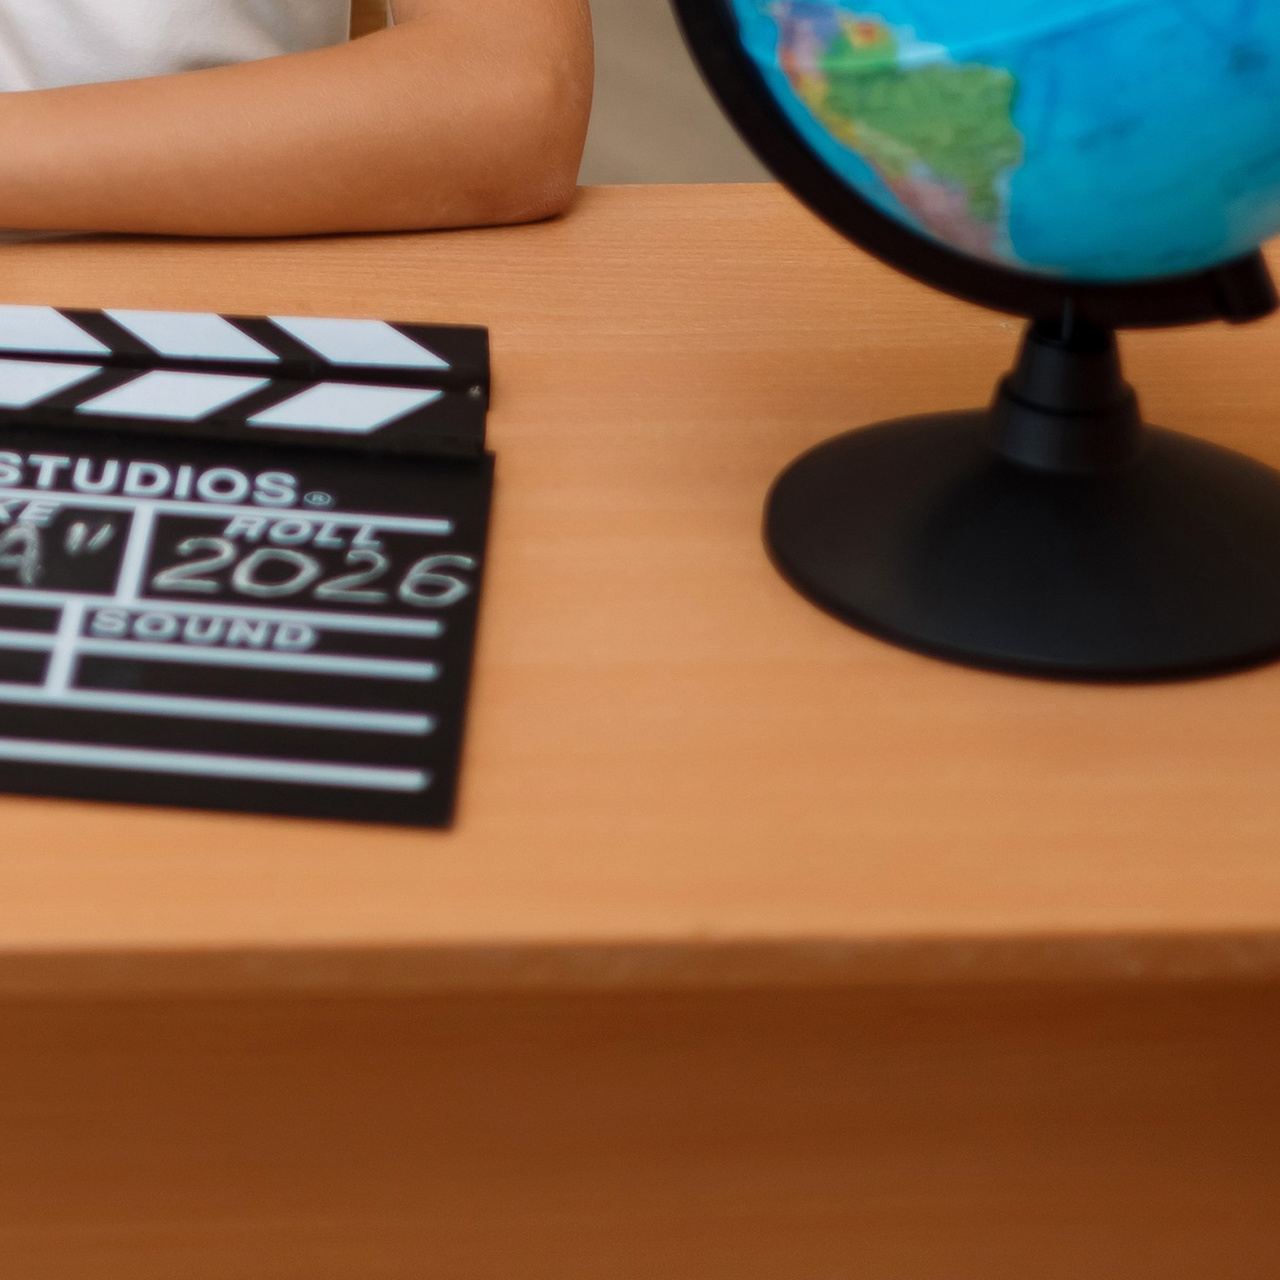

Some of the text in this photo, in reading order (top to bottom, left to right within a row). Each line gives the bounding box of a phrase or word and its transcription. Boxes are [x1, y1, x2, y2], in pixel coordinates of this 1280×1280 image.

[223, 514, 382, 549] ROLL
[151, 536, 475, 608] 2026
[91, 607, 318, 651] SOUND
